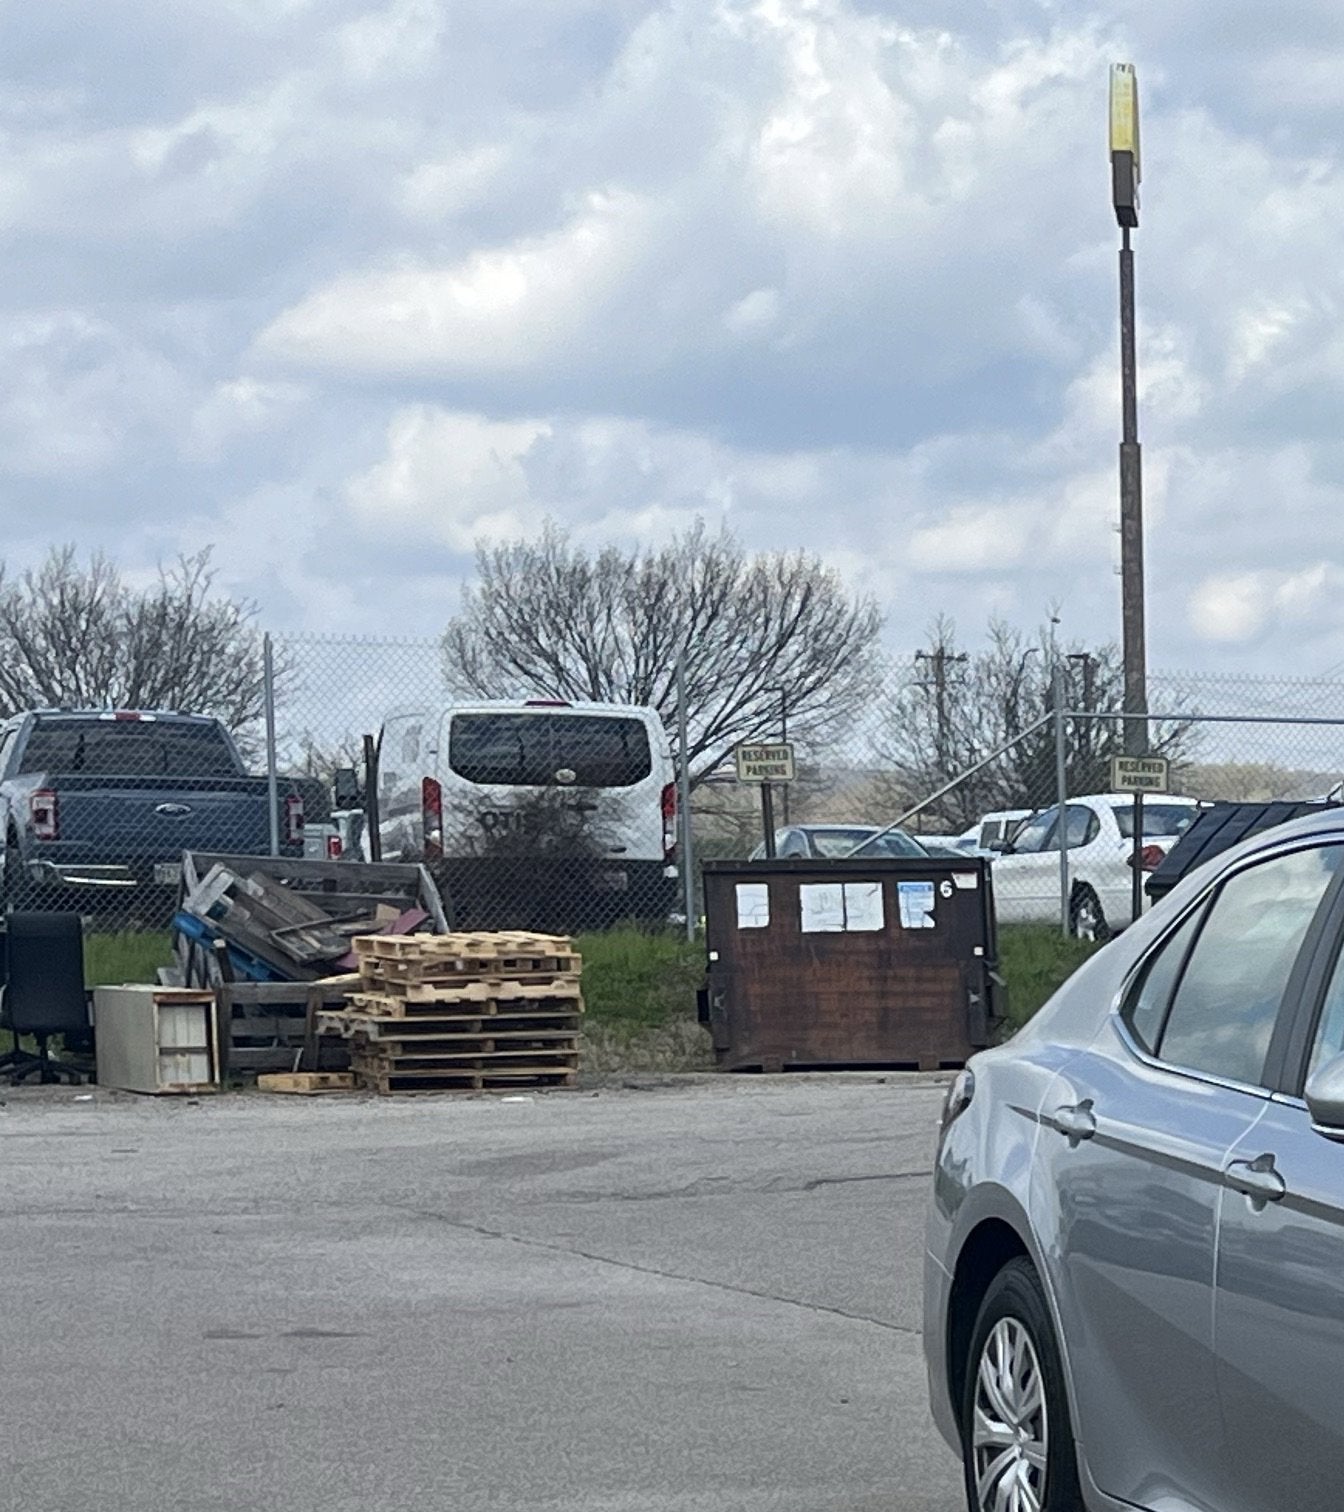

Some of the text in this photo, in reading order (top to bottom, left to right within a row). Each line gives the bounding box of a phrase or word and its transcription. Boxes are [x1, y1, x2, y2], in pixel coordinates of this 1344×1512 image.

[742, 749, 788, 761] RESERVED
[746, 764, 787, 775] PARKING
[1118, 761, 1164, 773] RESERVED
[1121, 774, 1161, 787] PARKING
[940, 880, 953, 898] 6
